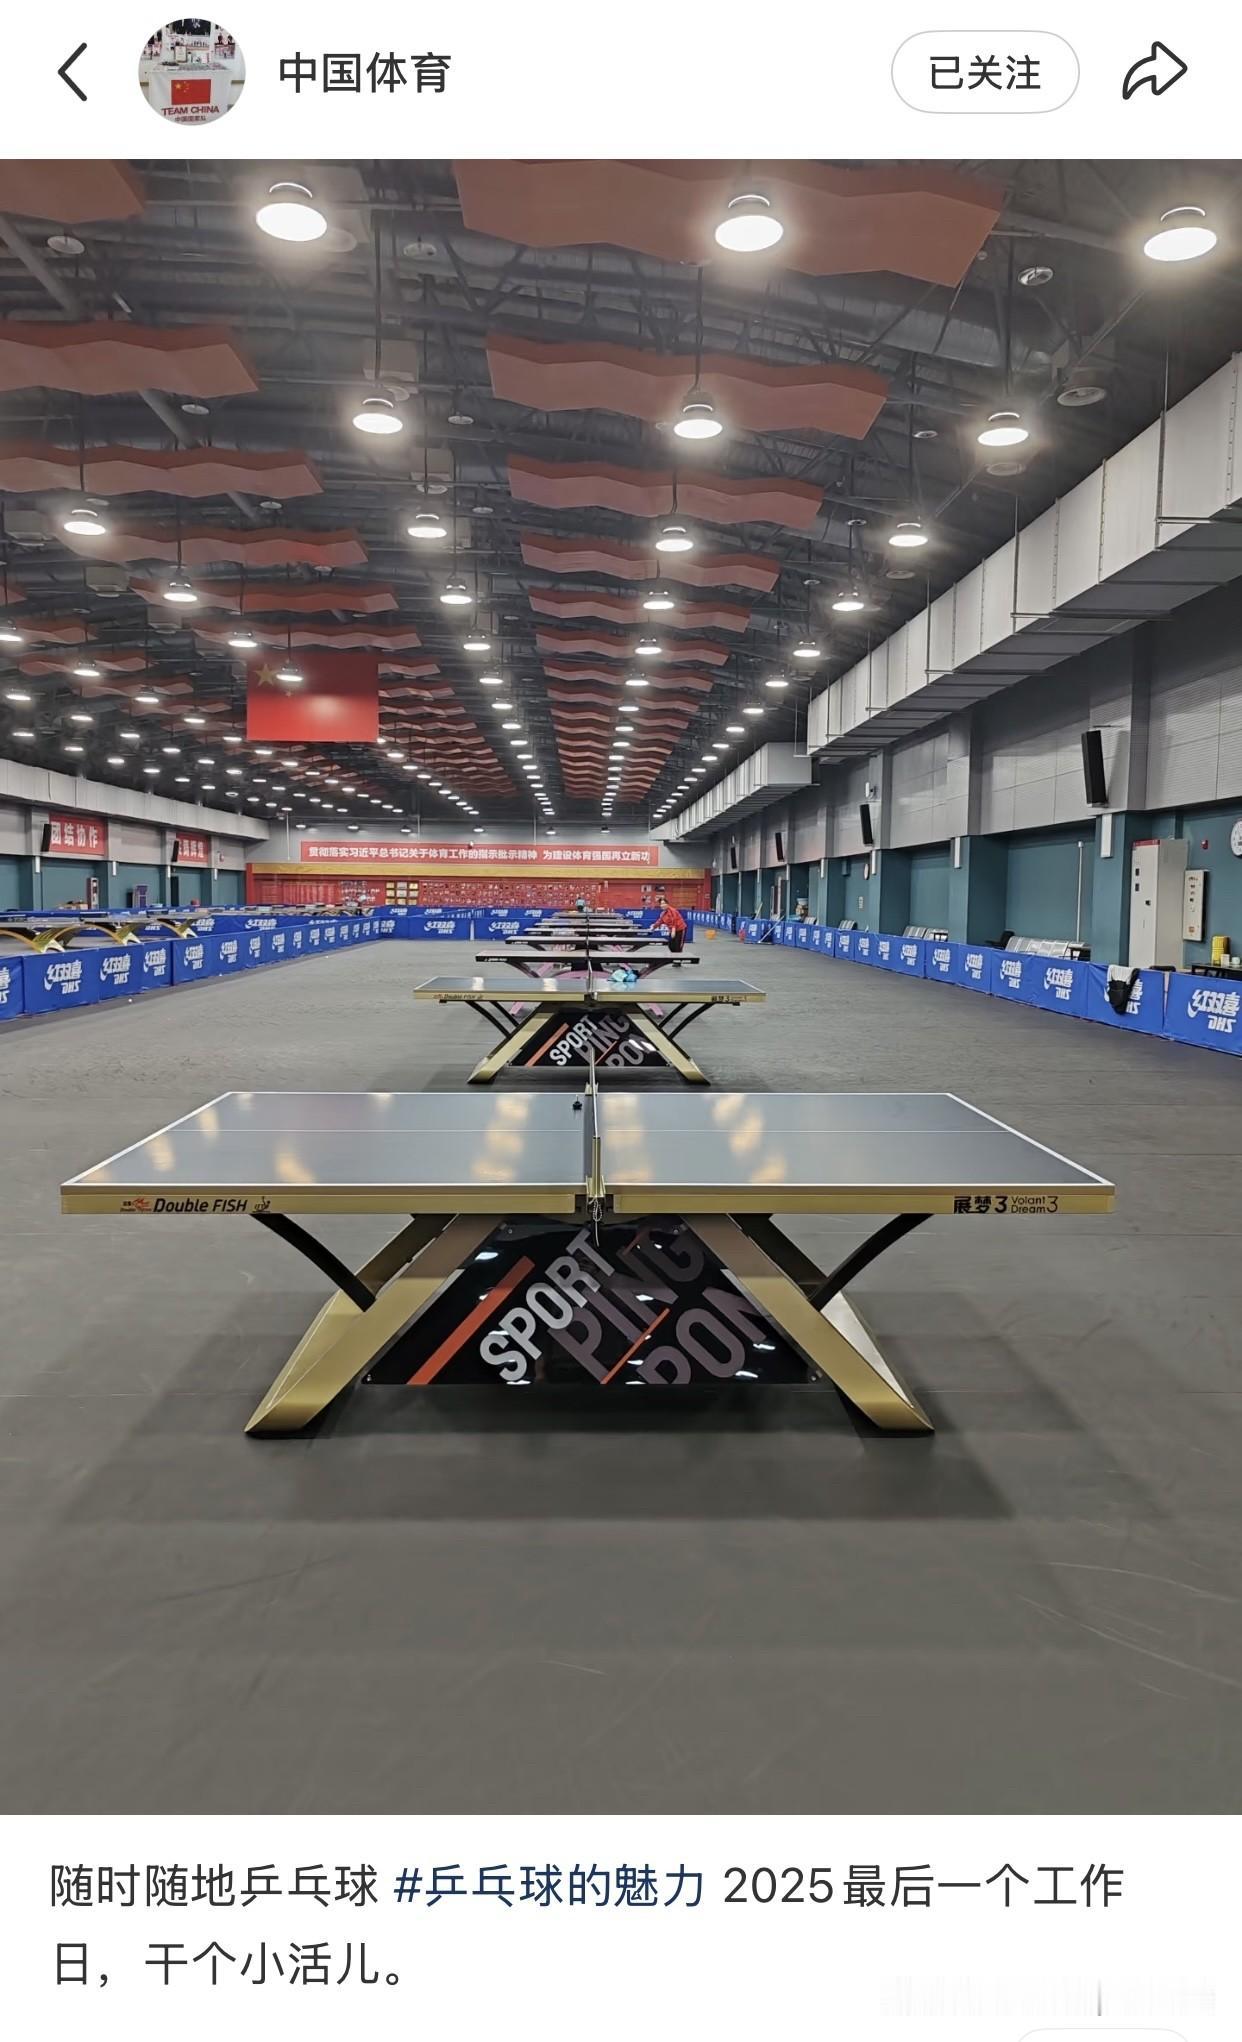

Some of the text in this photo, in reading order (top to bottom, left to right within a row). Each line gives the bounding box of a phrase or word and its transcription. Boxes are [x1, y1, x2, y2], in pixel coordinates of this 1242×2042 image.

[50, 821, 98, 848] 团结协作
[44, 959, 83, 991] 红双喜
[1187, 989, 1241, 1018] 红双喜
[1207, 1014, 1237, 1034] DHS
[550, 1014, 600, 1067] SPORT
[153, 1197, 208, 1213] Double
[212, 1198, 248, 1213] FISH
[1011, 1195, 1046, 1205] Volant
[1011, 1205, 1046, 1214] Dream
[479, 1227, 616, 1383] SPORT
[546, 1226, 704, 1384] PING
